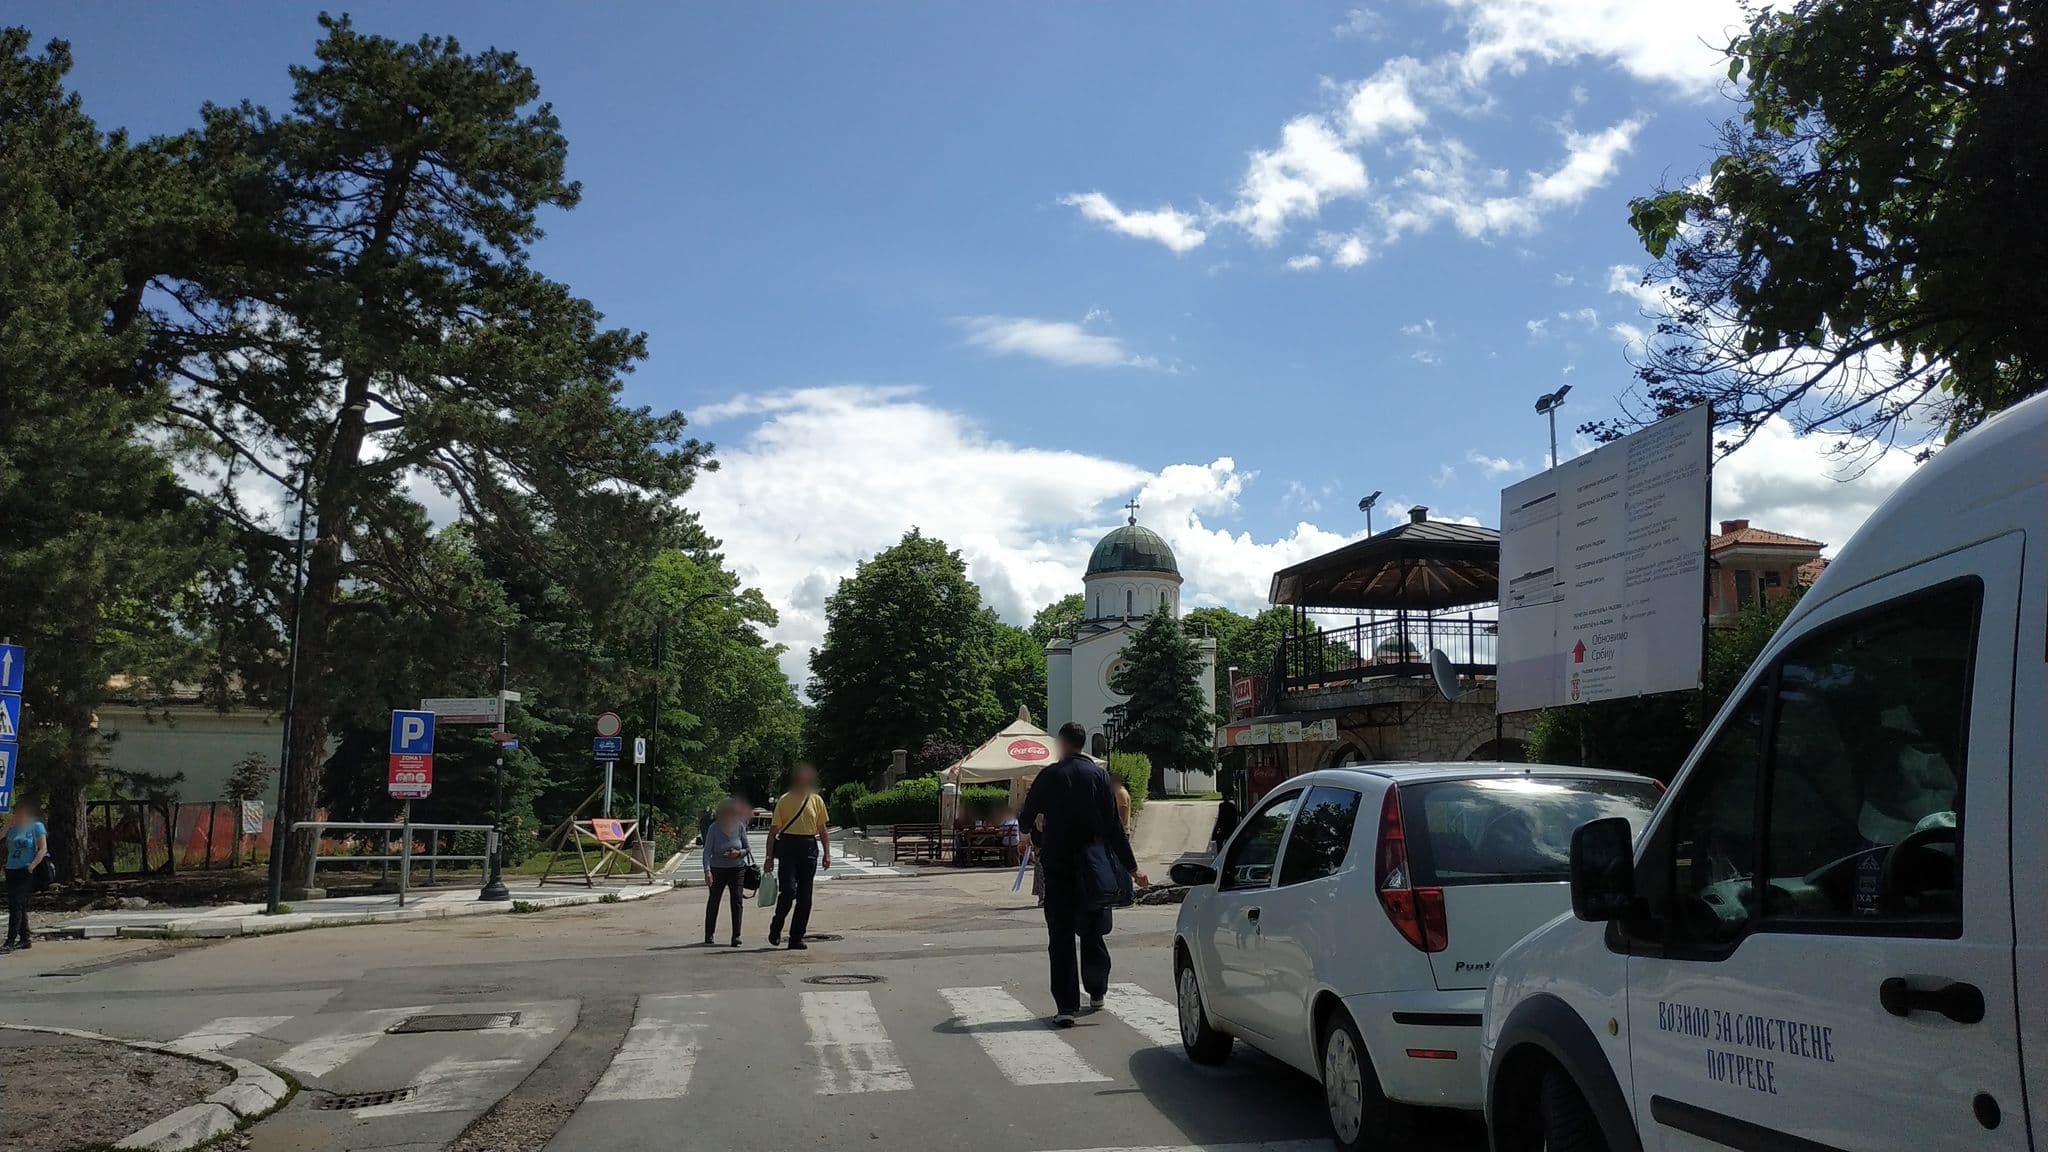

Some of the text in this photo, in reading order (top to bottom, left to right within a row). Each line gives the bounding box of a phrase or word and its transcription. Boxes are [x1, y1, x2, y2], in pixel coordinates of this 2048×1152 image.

[1591, 631, 1629, 646] Обновимо
[1591, 649, 1615, 662] Србију
[401, 716, 425, 749] P
[1455, 960, 1495, 972] Punt
[1658, 1001, 1835, 1063] ВОЗИЛО ЗА СОПСТВЕНЕ
[1706, 1048, 1778, 1095] ПОТРЕБЕ
